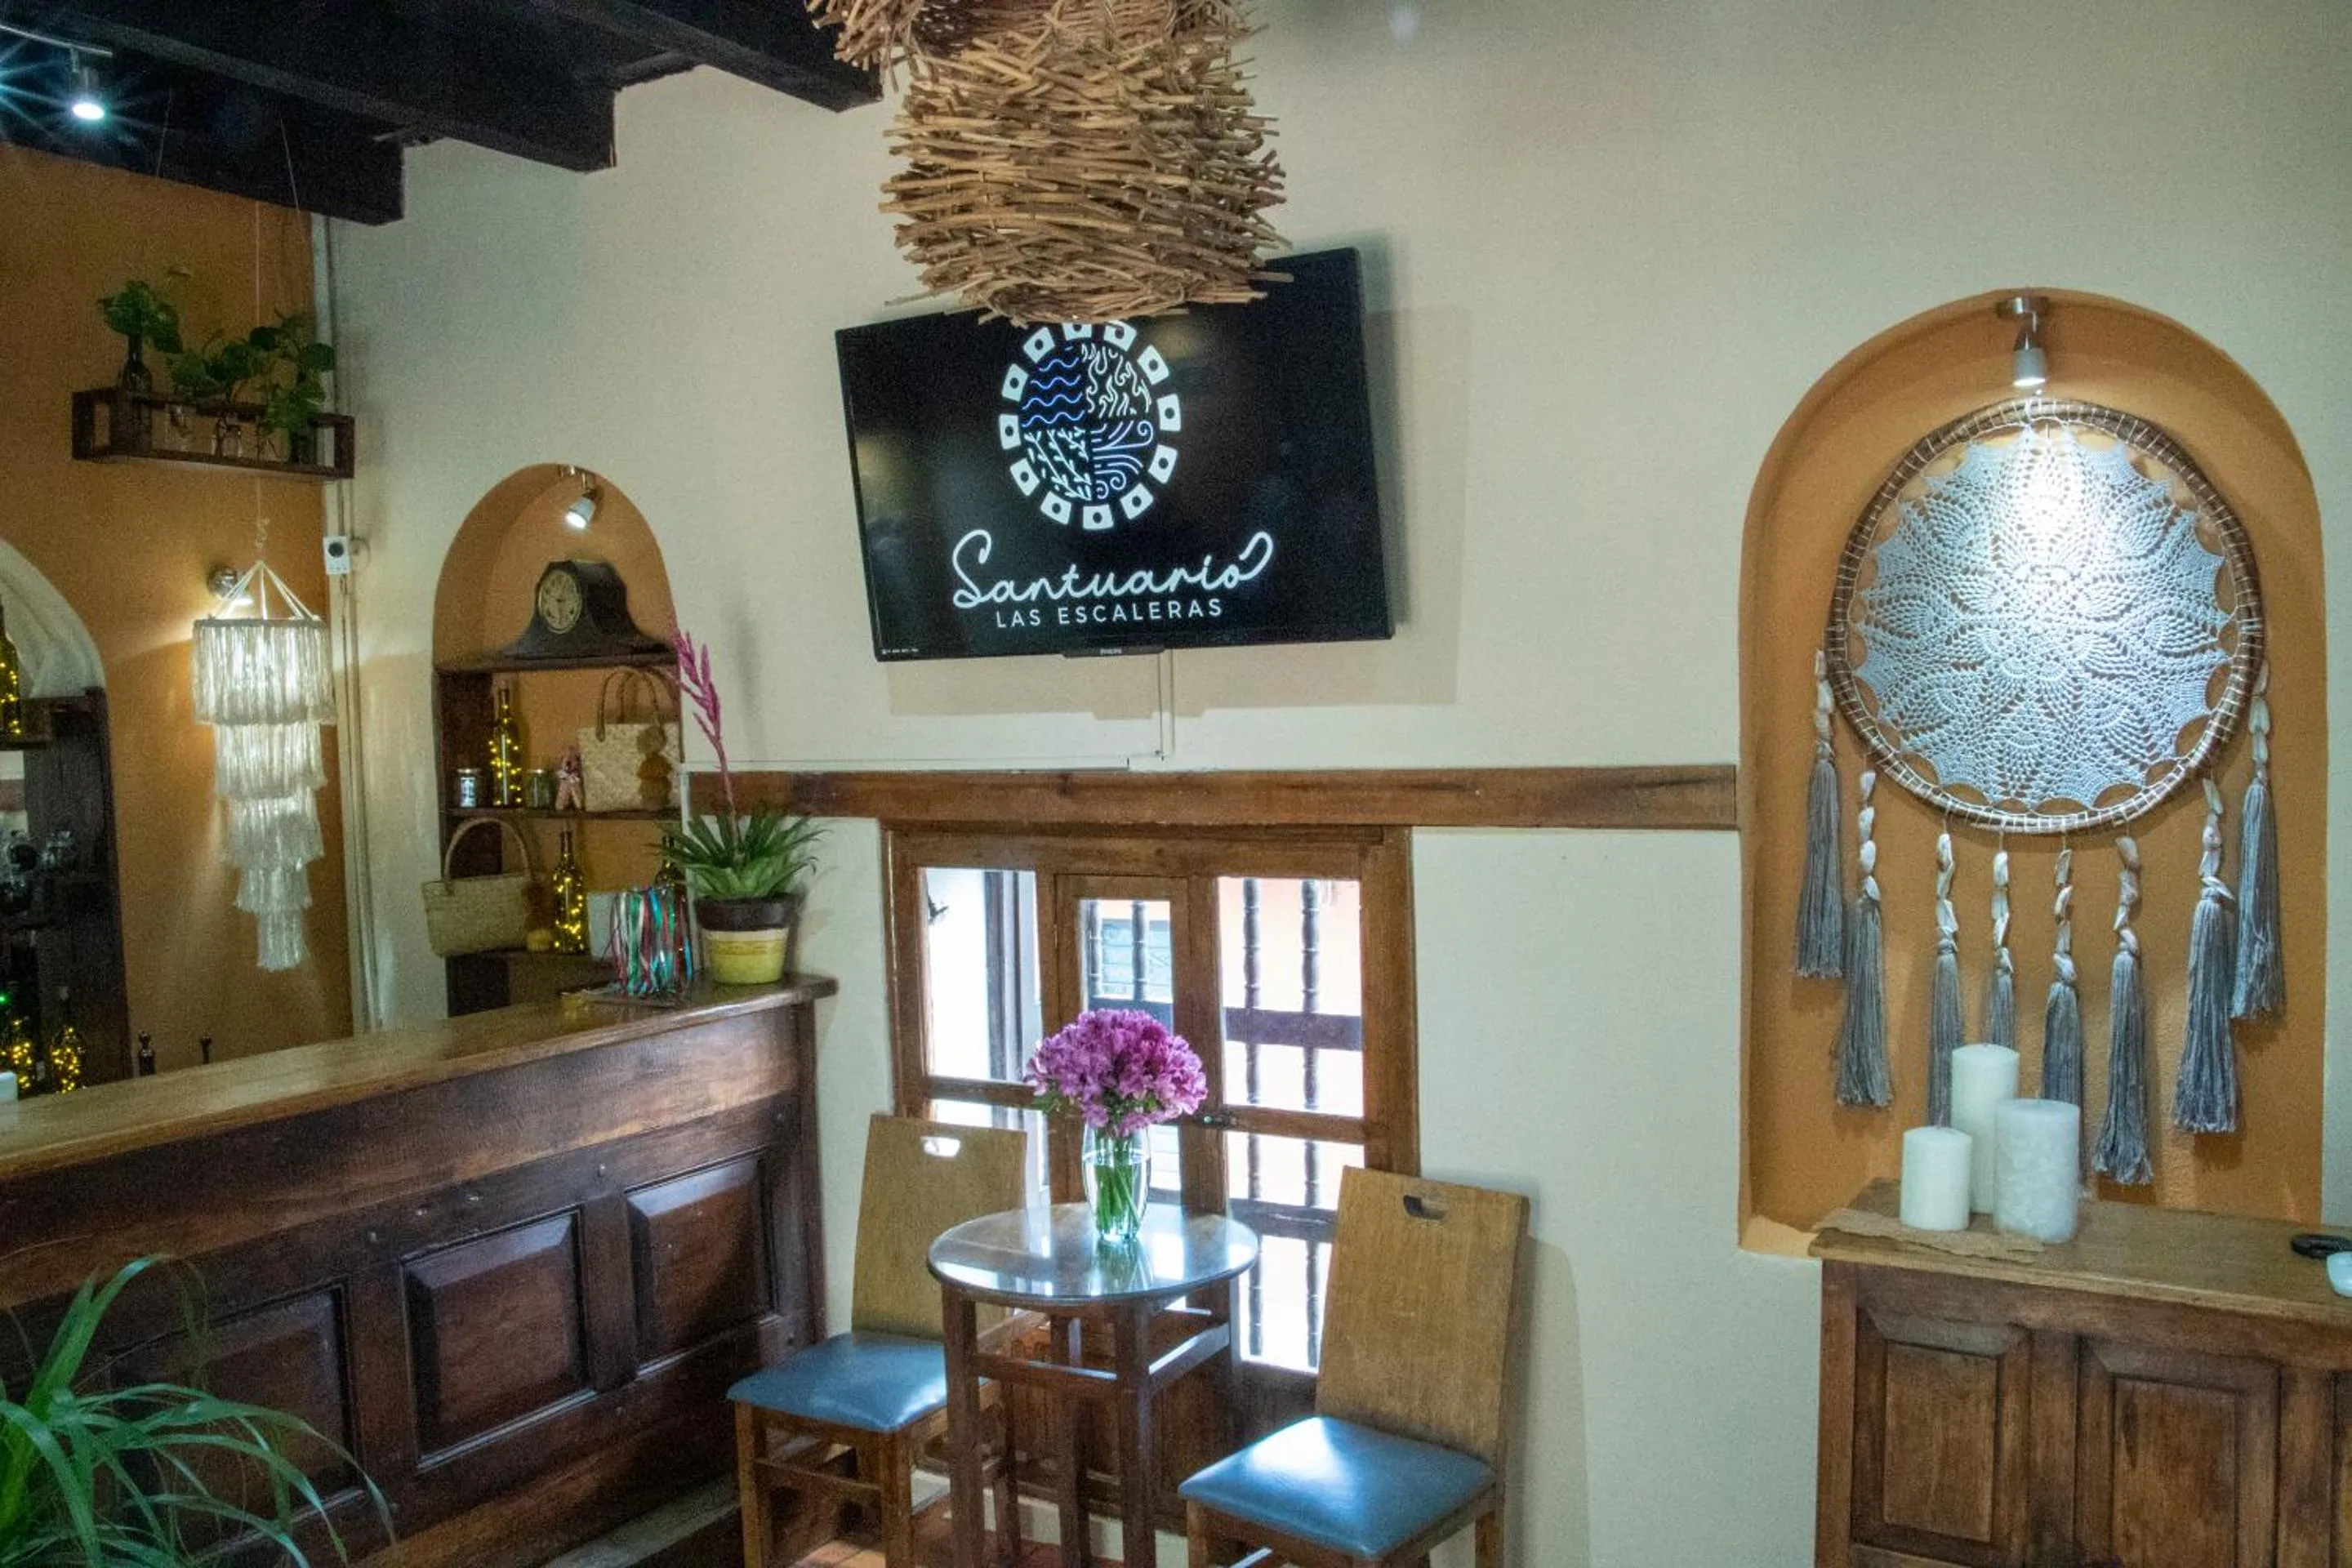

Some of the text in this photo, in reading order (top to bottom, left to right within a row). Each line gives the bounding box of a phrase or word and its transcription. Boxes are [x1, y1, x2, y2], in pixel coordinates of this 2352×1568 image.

[951, 528, 1274, 609] Santuario
[996, 598, 1223, 628] LAS ESCALERAS
